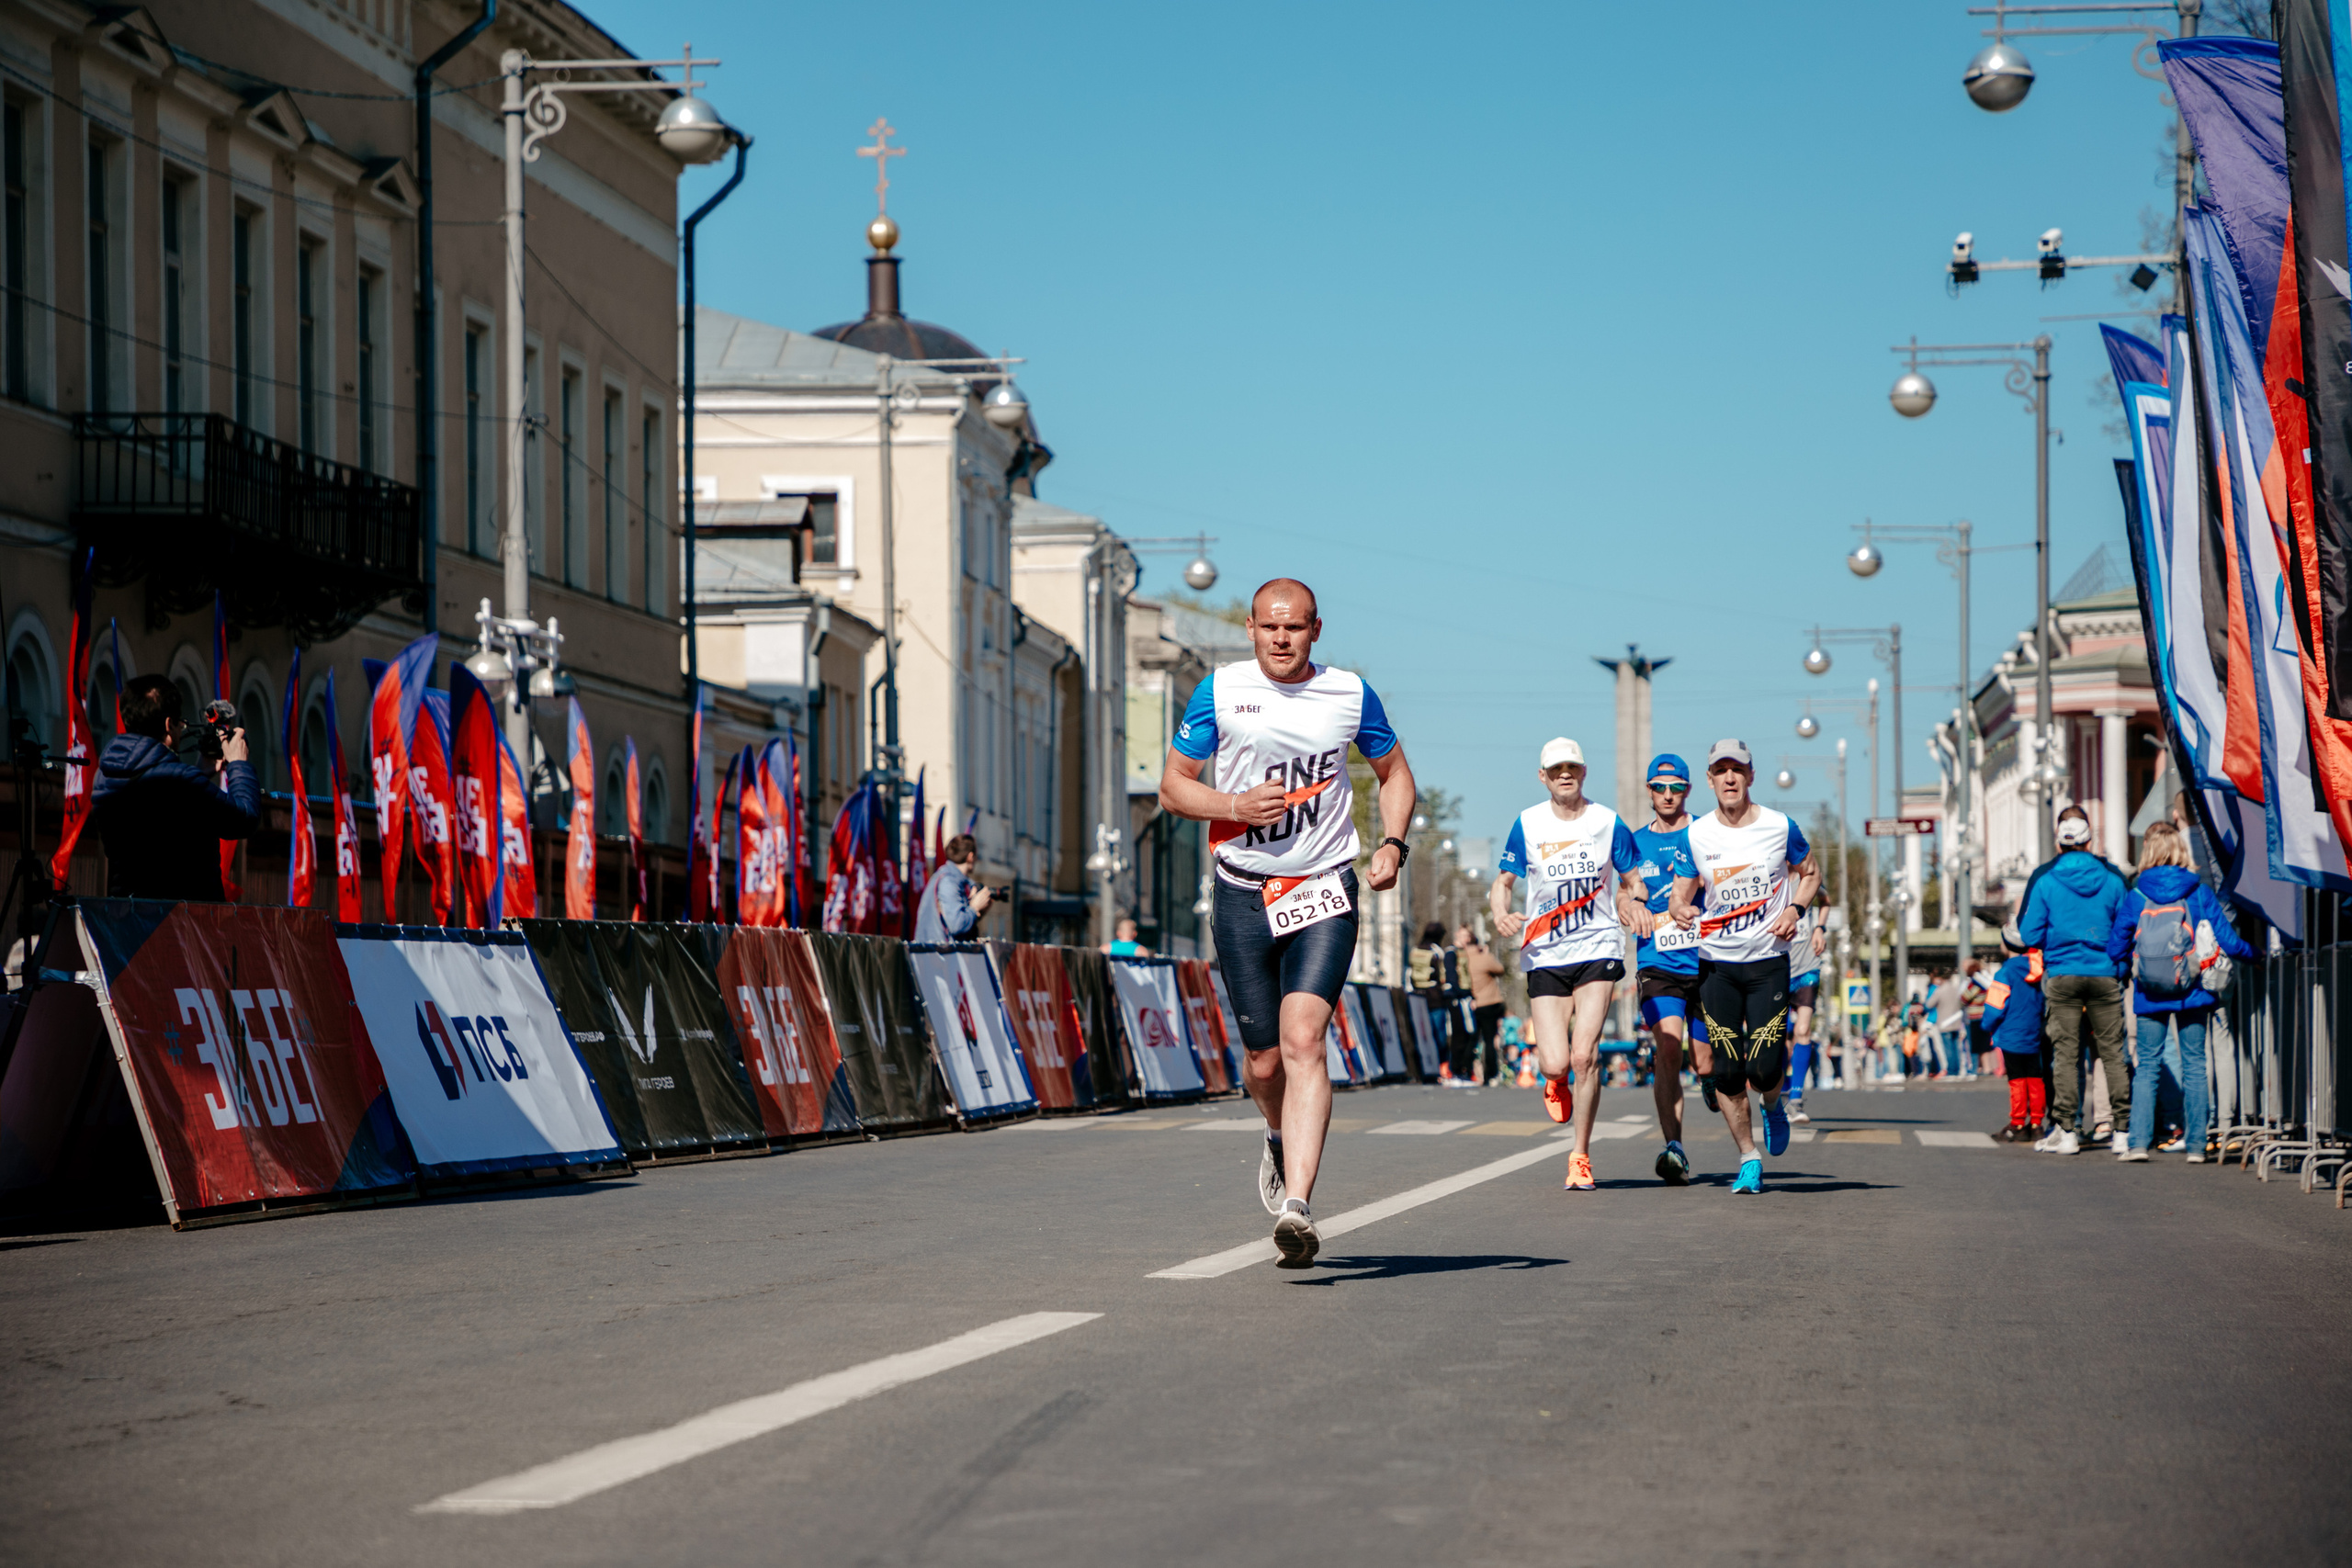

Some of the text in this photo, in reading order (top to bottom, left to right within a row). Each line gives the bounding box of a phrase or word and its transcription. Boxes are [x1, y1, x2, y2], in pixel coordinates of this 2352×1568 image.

[1265, 748, 1340, 795] ONE
[1548, 861, 1595, 876] 00138
[1269, 881, 1283, 893] 10
[1722, 883, 1769, 901] 00137
[1275, 896, 1345, 928] 05218
[1550, 899, 1595, 942] RUN
[450, 1015, 528, 1083] ПСБ
